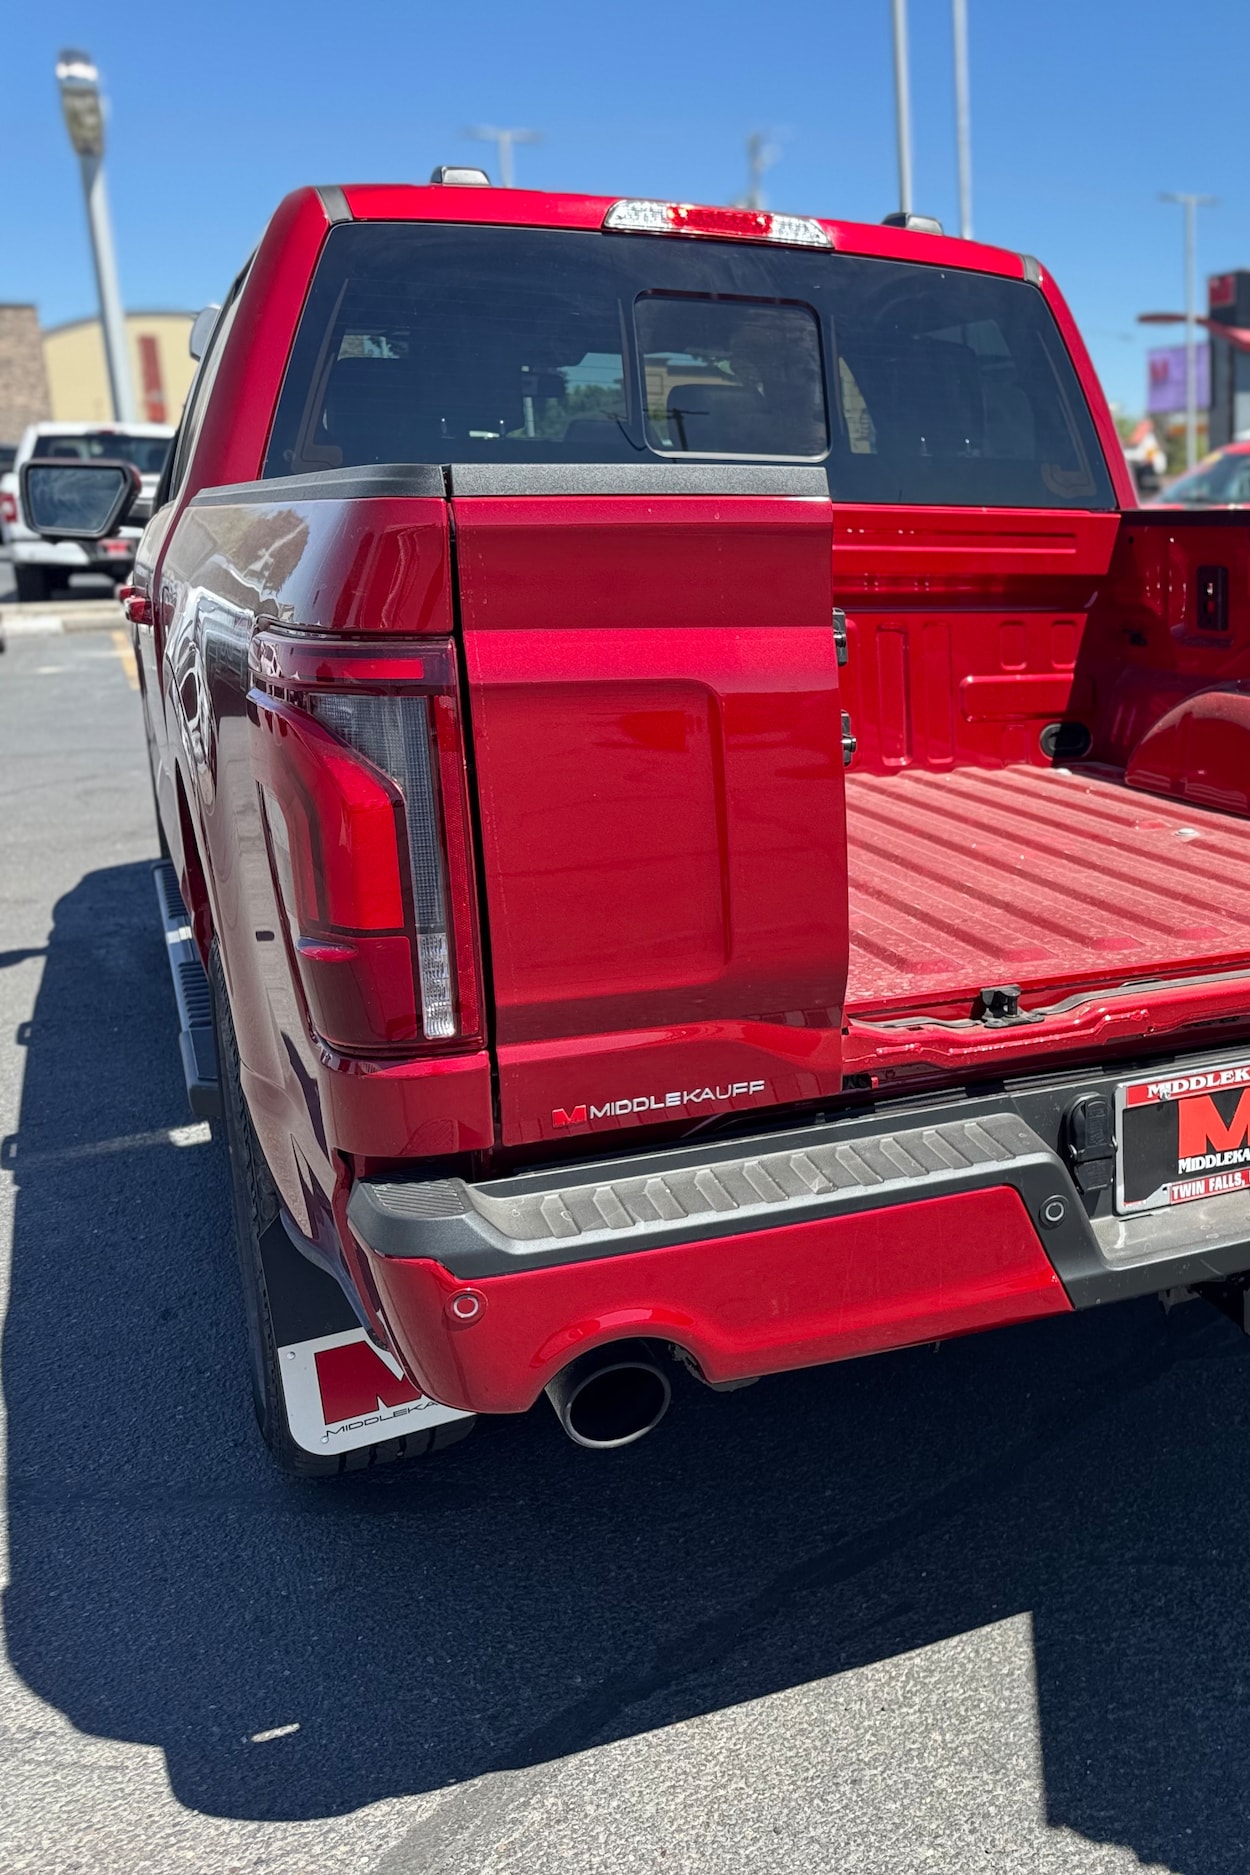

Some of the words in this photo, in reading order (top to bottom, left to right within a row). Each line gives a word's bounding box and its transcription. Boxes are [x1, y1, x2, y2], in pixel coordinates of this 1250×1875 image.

[589, 1080, 765, 1119] MIDDLEKAUFF
[1172, 1180, 1206, 1200] TWIN
[1208, 1170, 1246, 1192] FALLS,
[325, 1401, 439, 1438] MIDDLEKA
